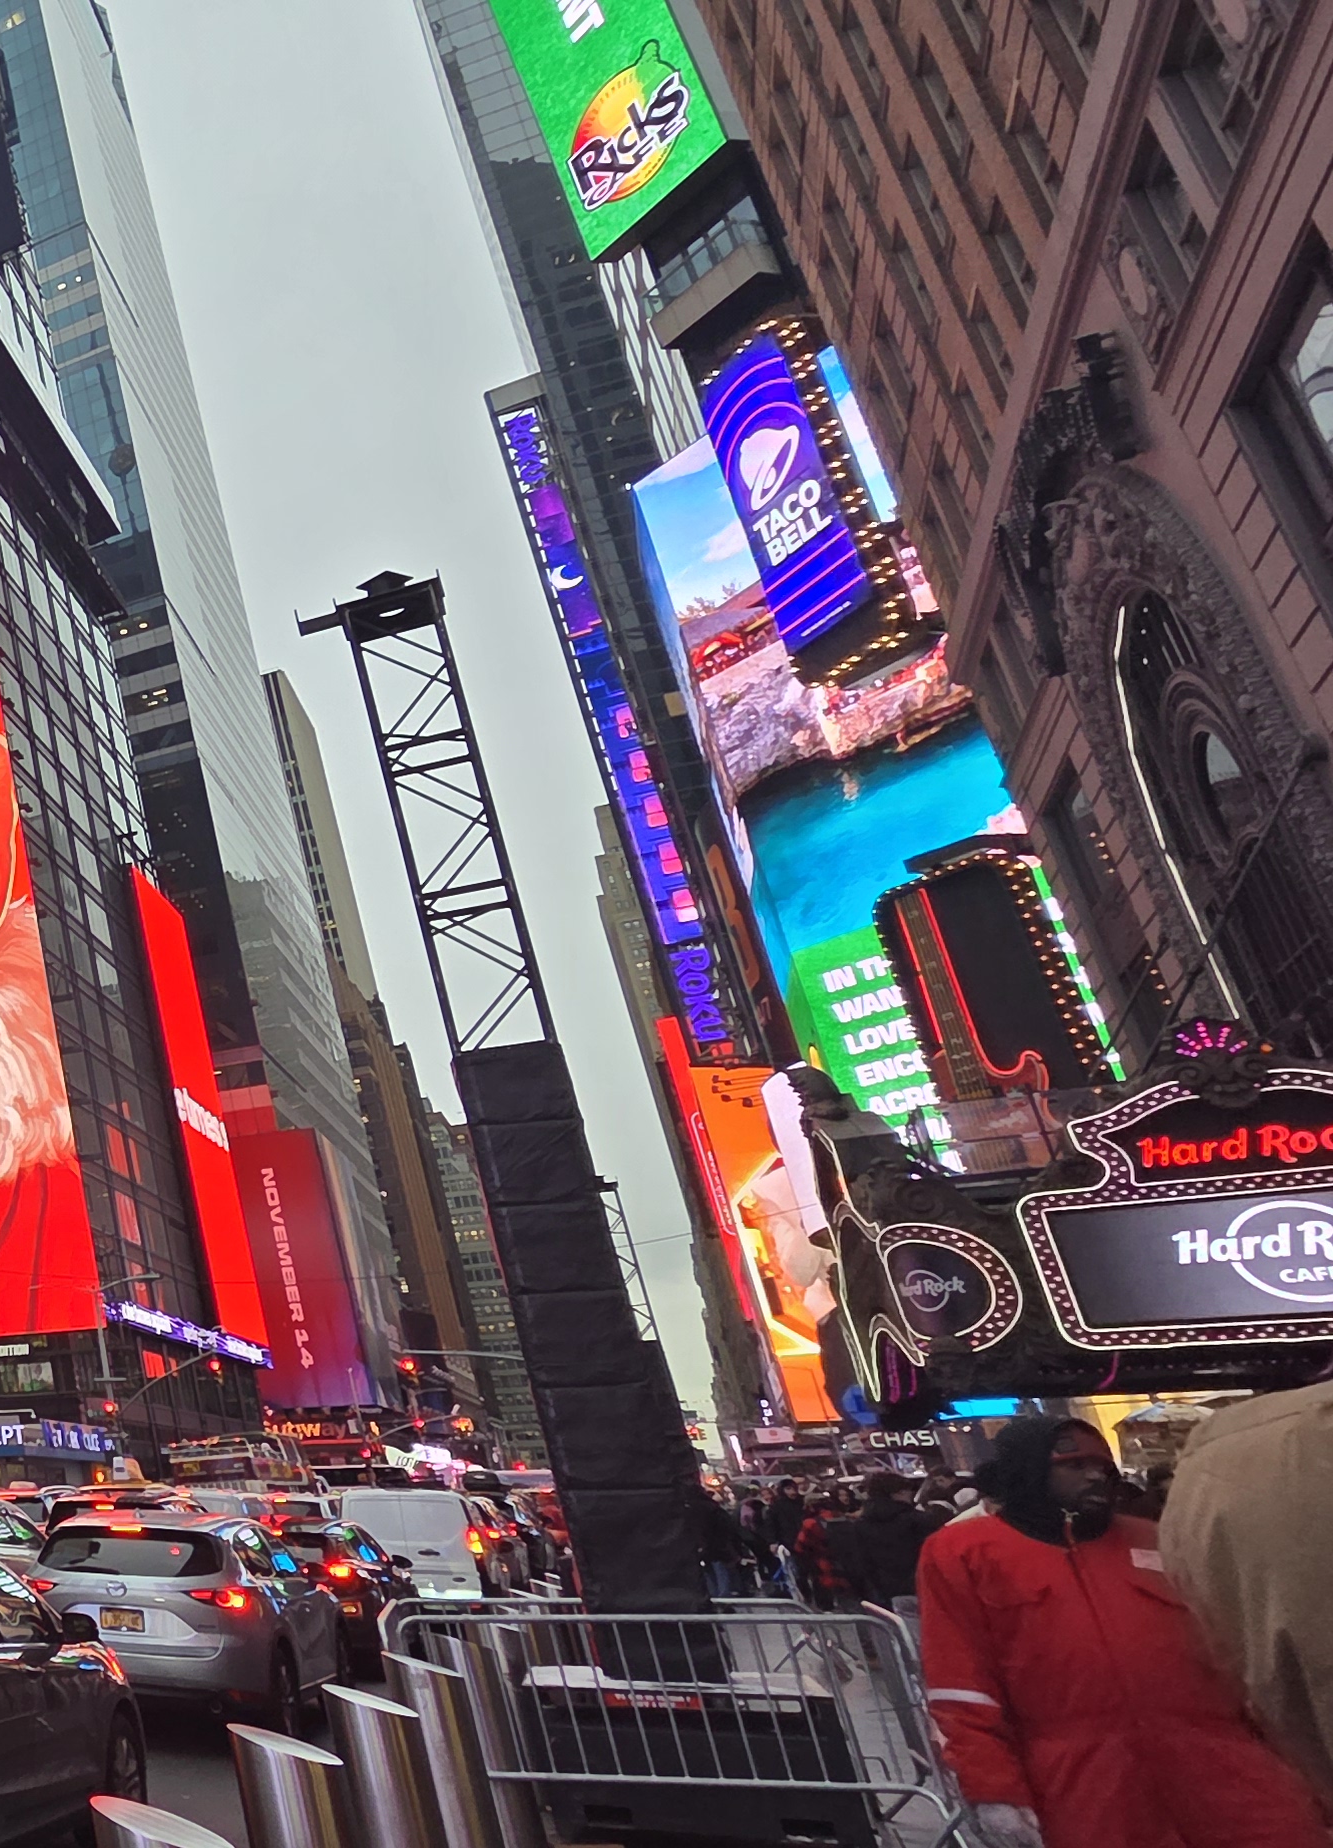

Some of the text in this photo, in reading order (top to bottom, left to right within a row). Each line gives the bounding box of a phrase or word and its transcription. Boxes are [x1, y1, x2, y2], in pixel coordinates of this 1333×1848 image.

[752, 478, 822, 543] TACO
[764, 507, 834, 568] BELL
[822, 965, 857, 993] IN
[843, 1016, 917, 1055] LOVE
[1136, 1127, 1248, 1169] Hard
[1172, 1223, 1291, 1265] Hard
[261, 1167, 315, 1369] NOVEMBER 14
[924, 1275, 967, 1296] Rock
